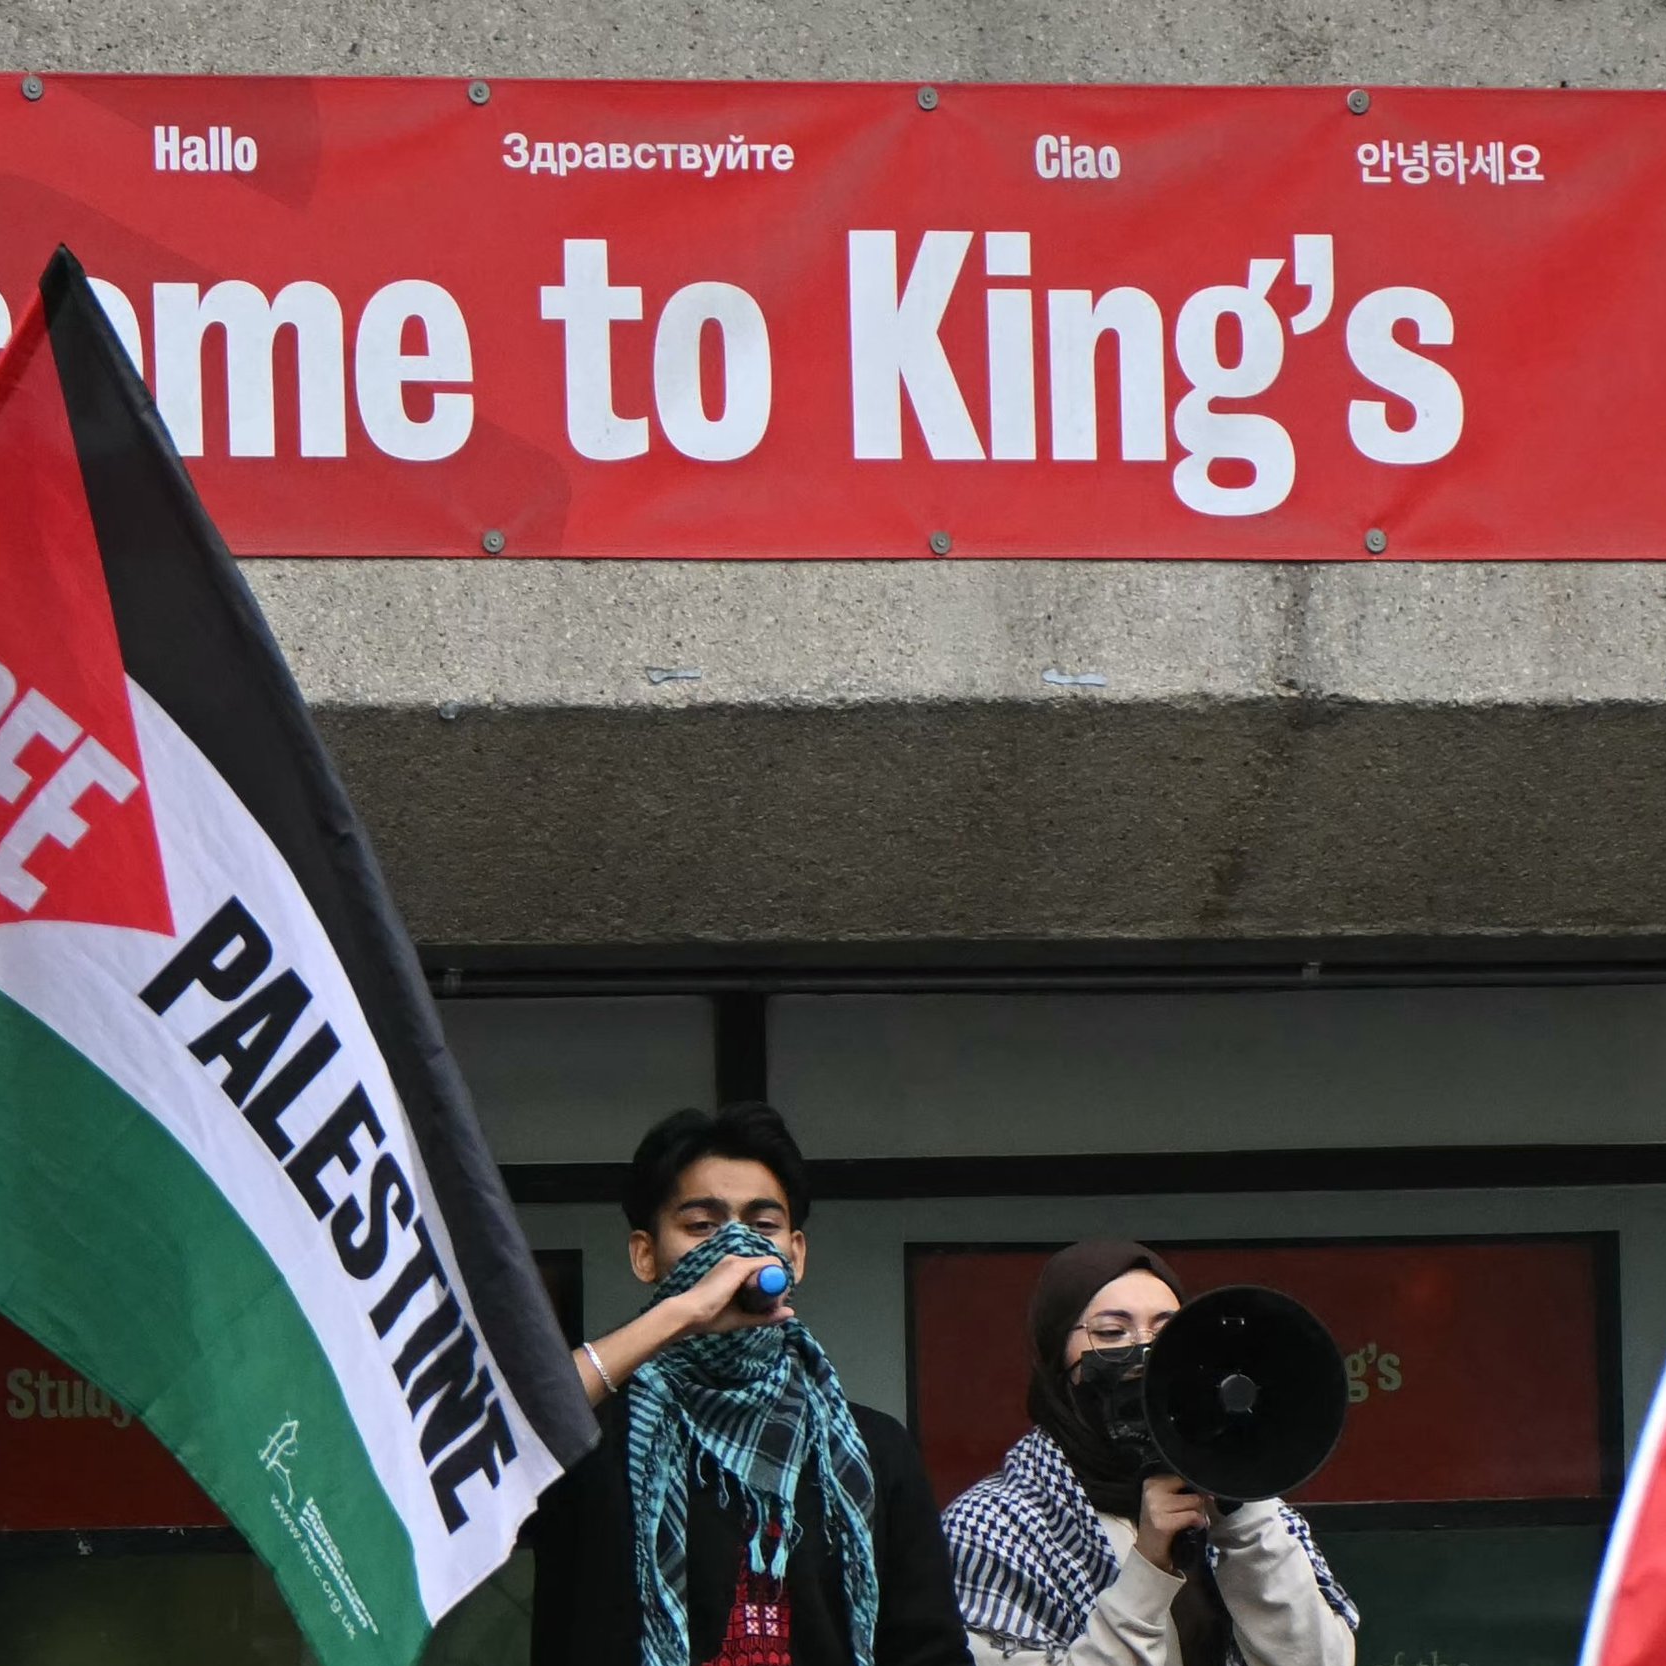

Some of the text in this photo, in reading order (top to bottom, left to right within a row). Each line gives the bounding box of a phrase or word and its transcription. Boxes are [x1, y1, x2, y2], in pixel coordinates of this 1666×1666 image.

[154, 125, 258, 172] Hallo
[502, 132, 795, 178] Здравствуйте
[1035, 134, 1121, 179] Ciao
[1356, 139, 1545, 186] 안녕하세요
[541, 238, 772, 462] to
[848, 229, 1464, 517] King's
[137, 894, 520, 1537] PALESTINE
